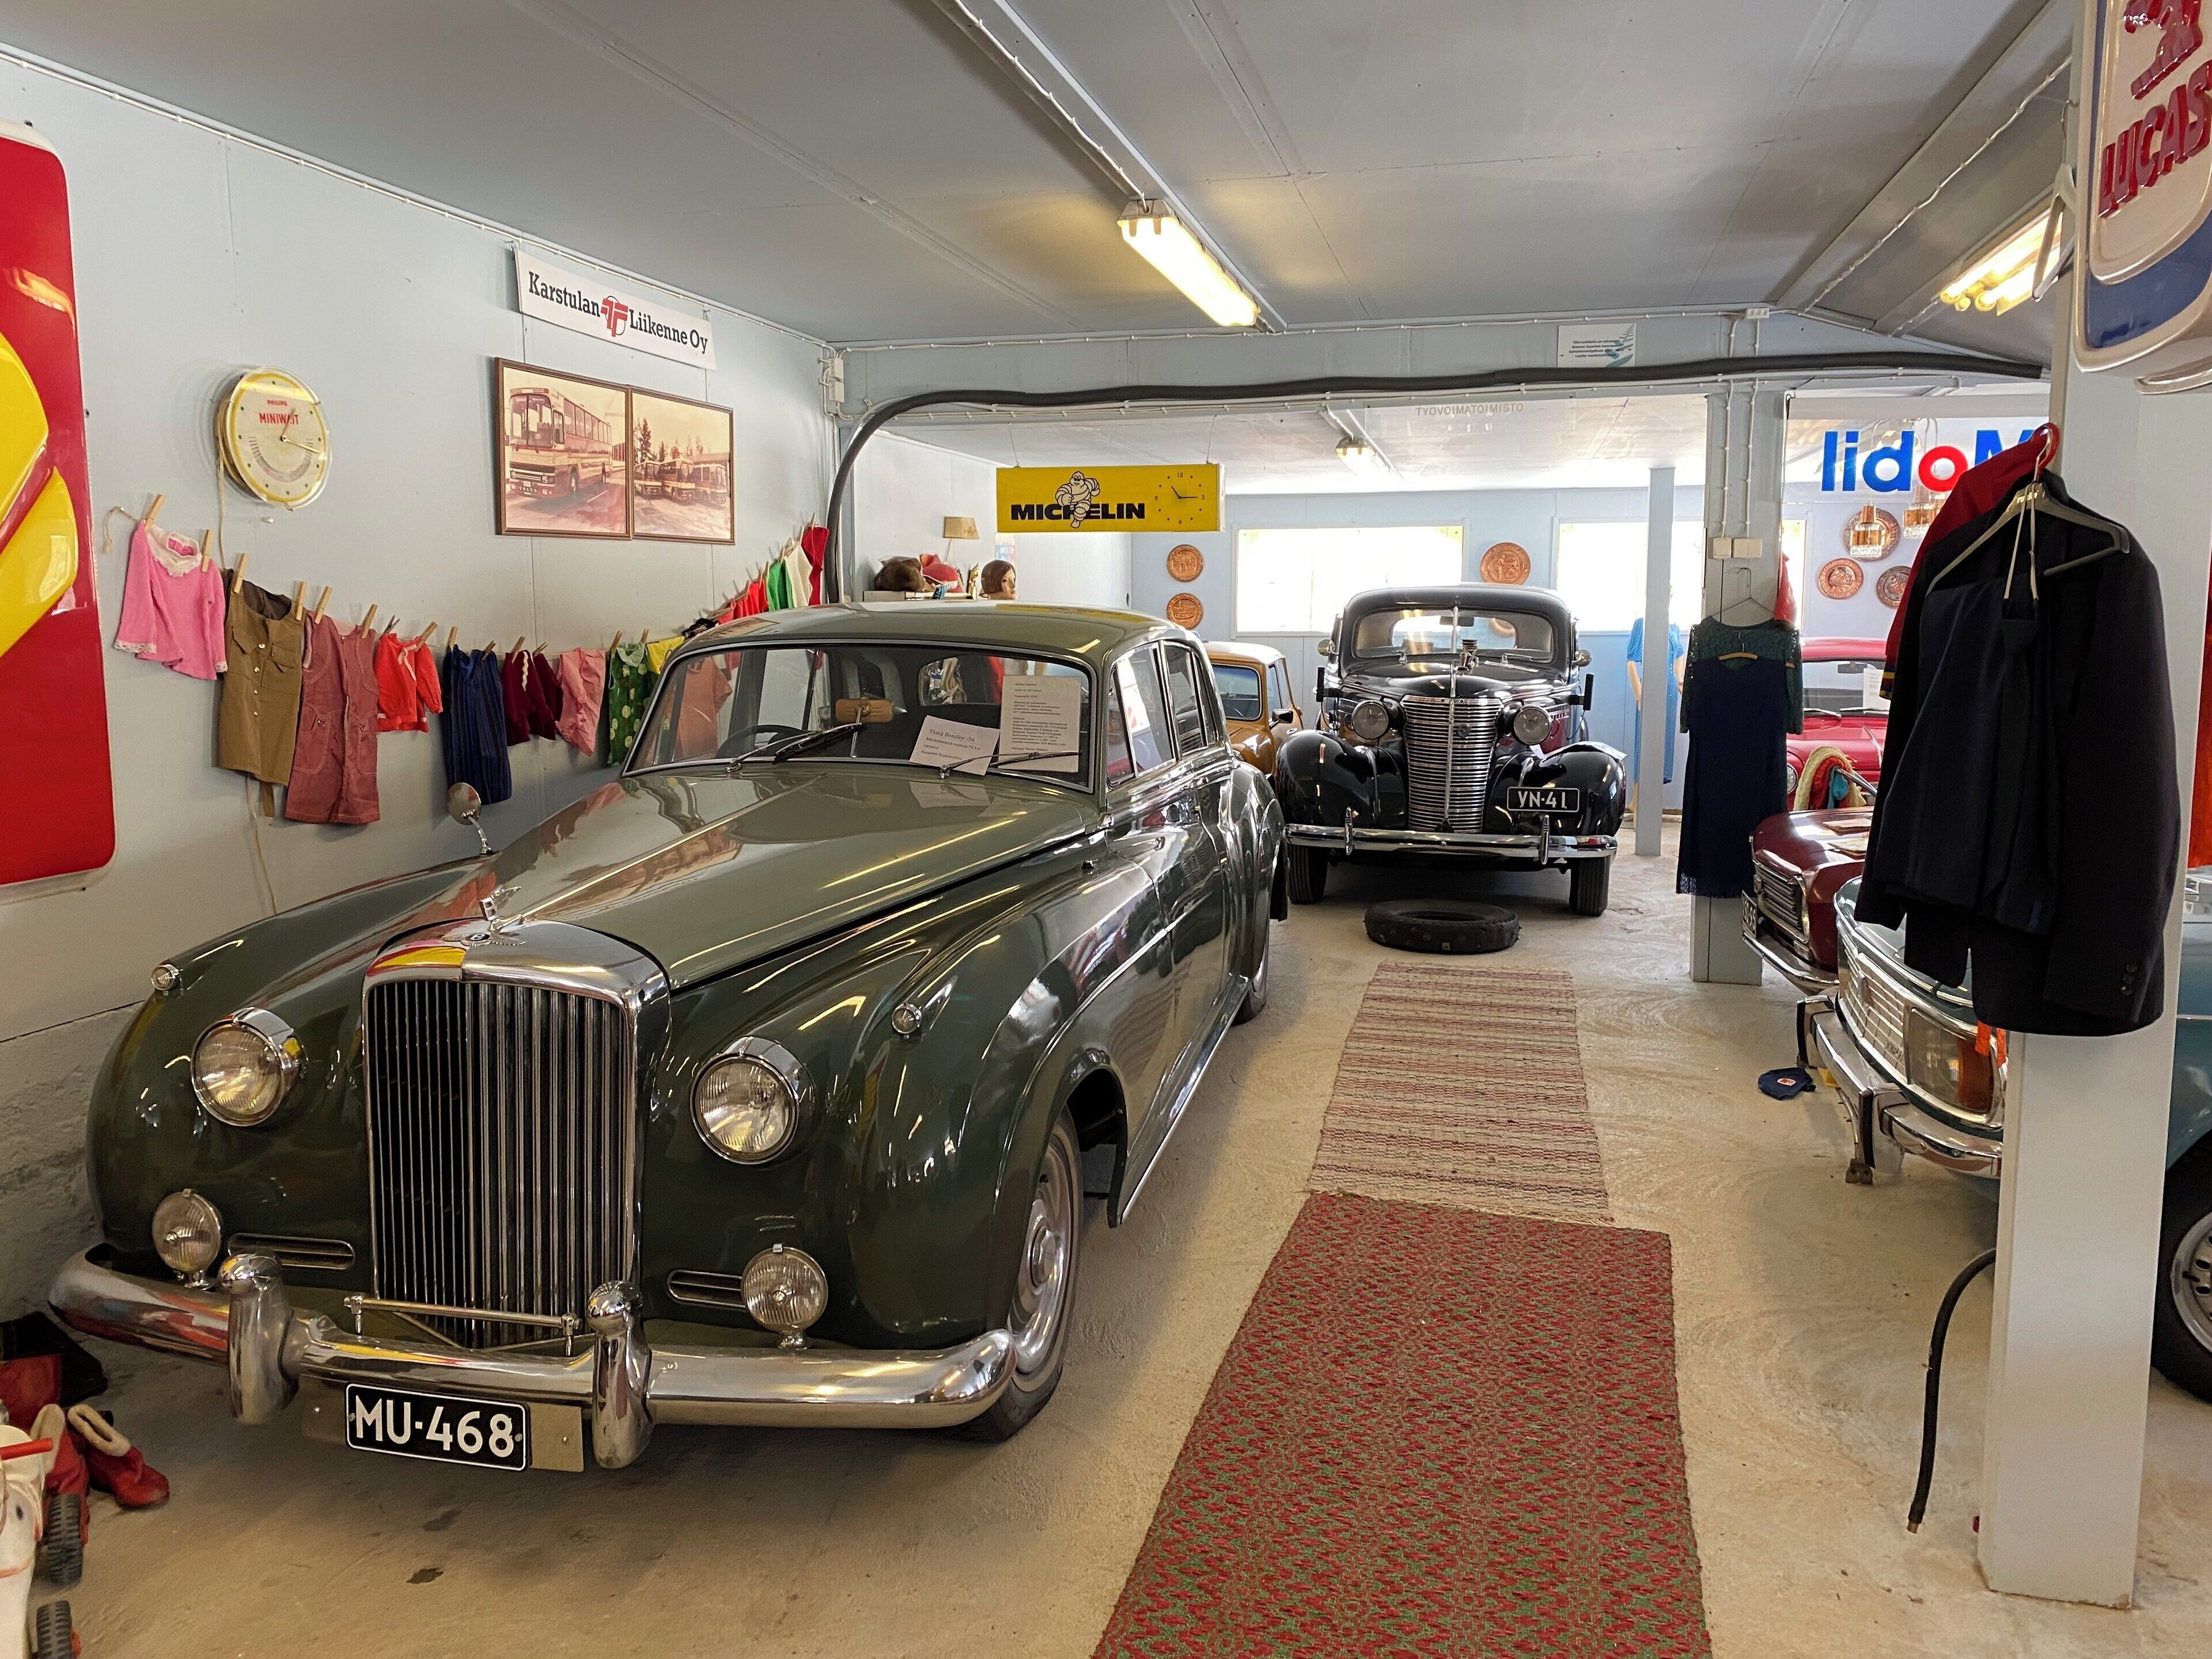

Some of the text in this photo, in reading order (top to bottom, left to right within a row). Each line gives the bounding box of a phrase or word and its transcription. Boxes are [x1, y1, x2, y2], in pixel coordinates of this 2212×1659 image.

[2097, 59, 2212, 218] LUCAS
[528, 271, 708, 354] Karstulan Liikenne Oy
[1010, 502, 1146, 520] MICHELIN
[945, 732, 965, 741] Bentley
[1518, 790, 1567, 809] VN-41
[355, 1395, 514, 1458] MU-468
